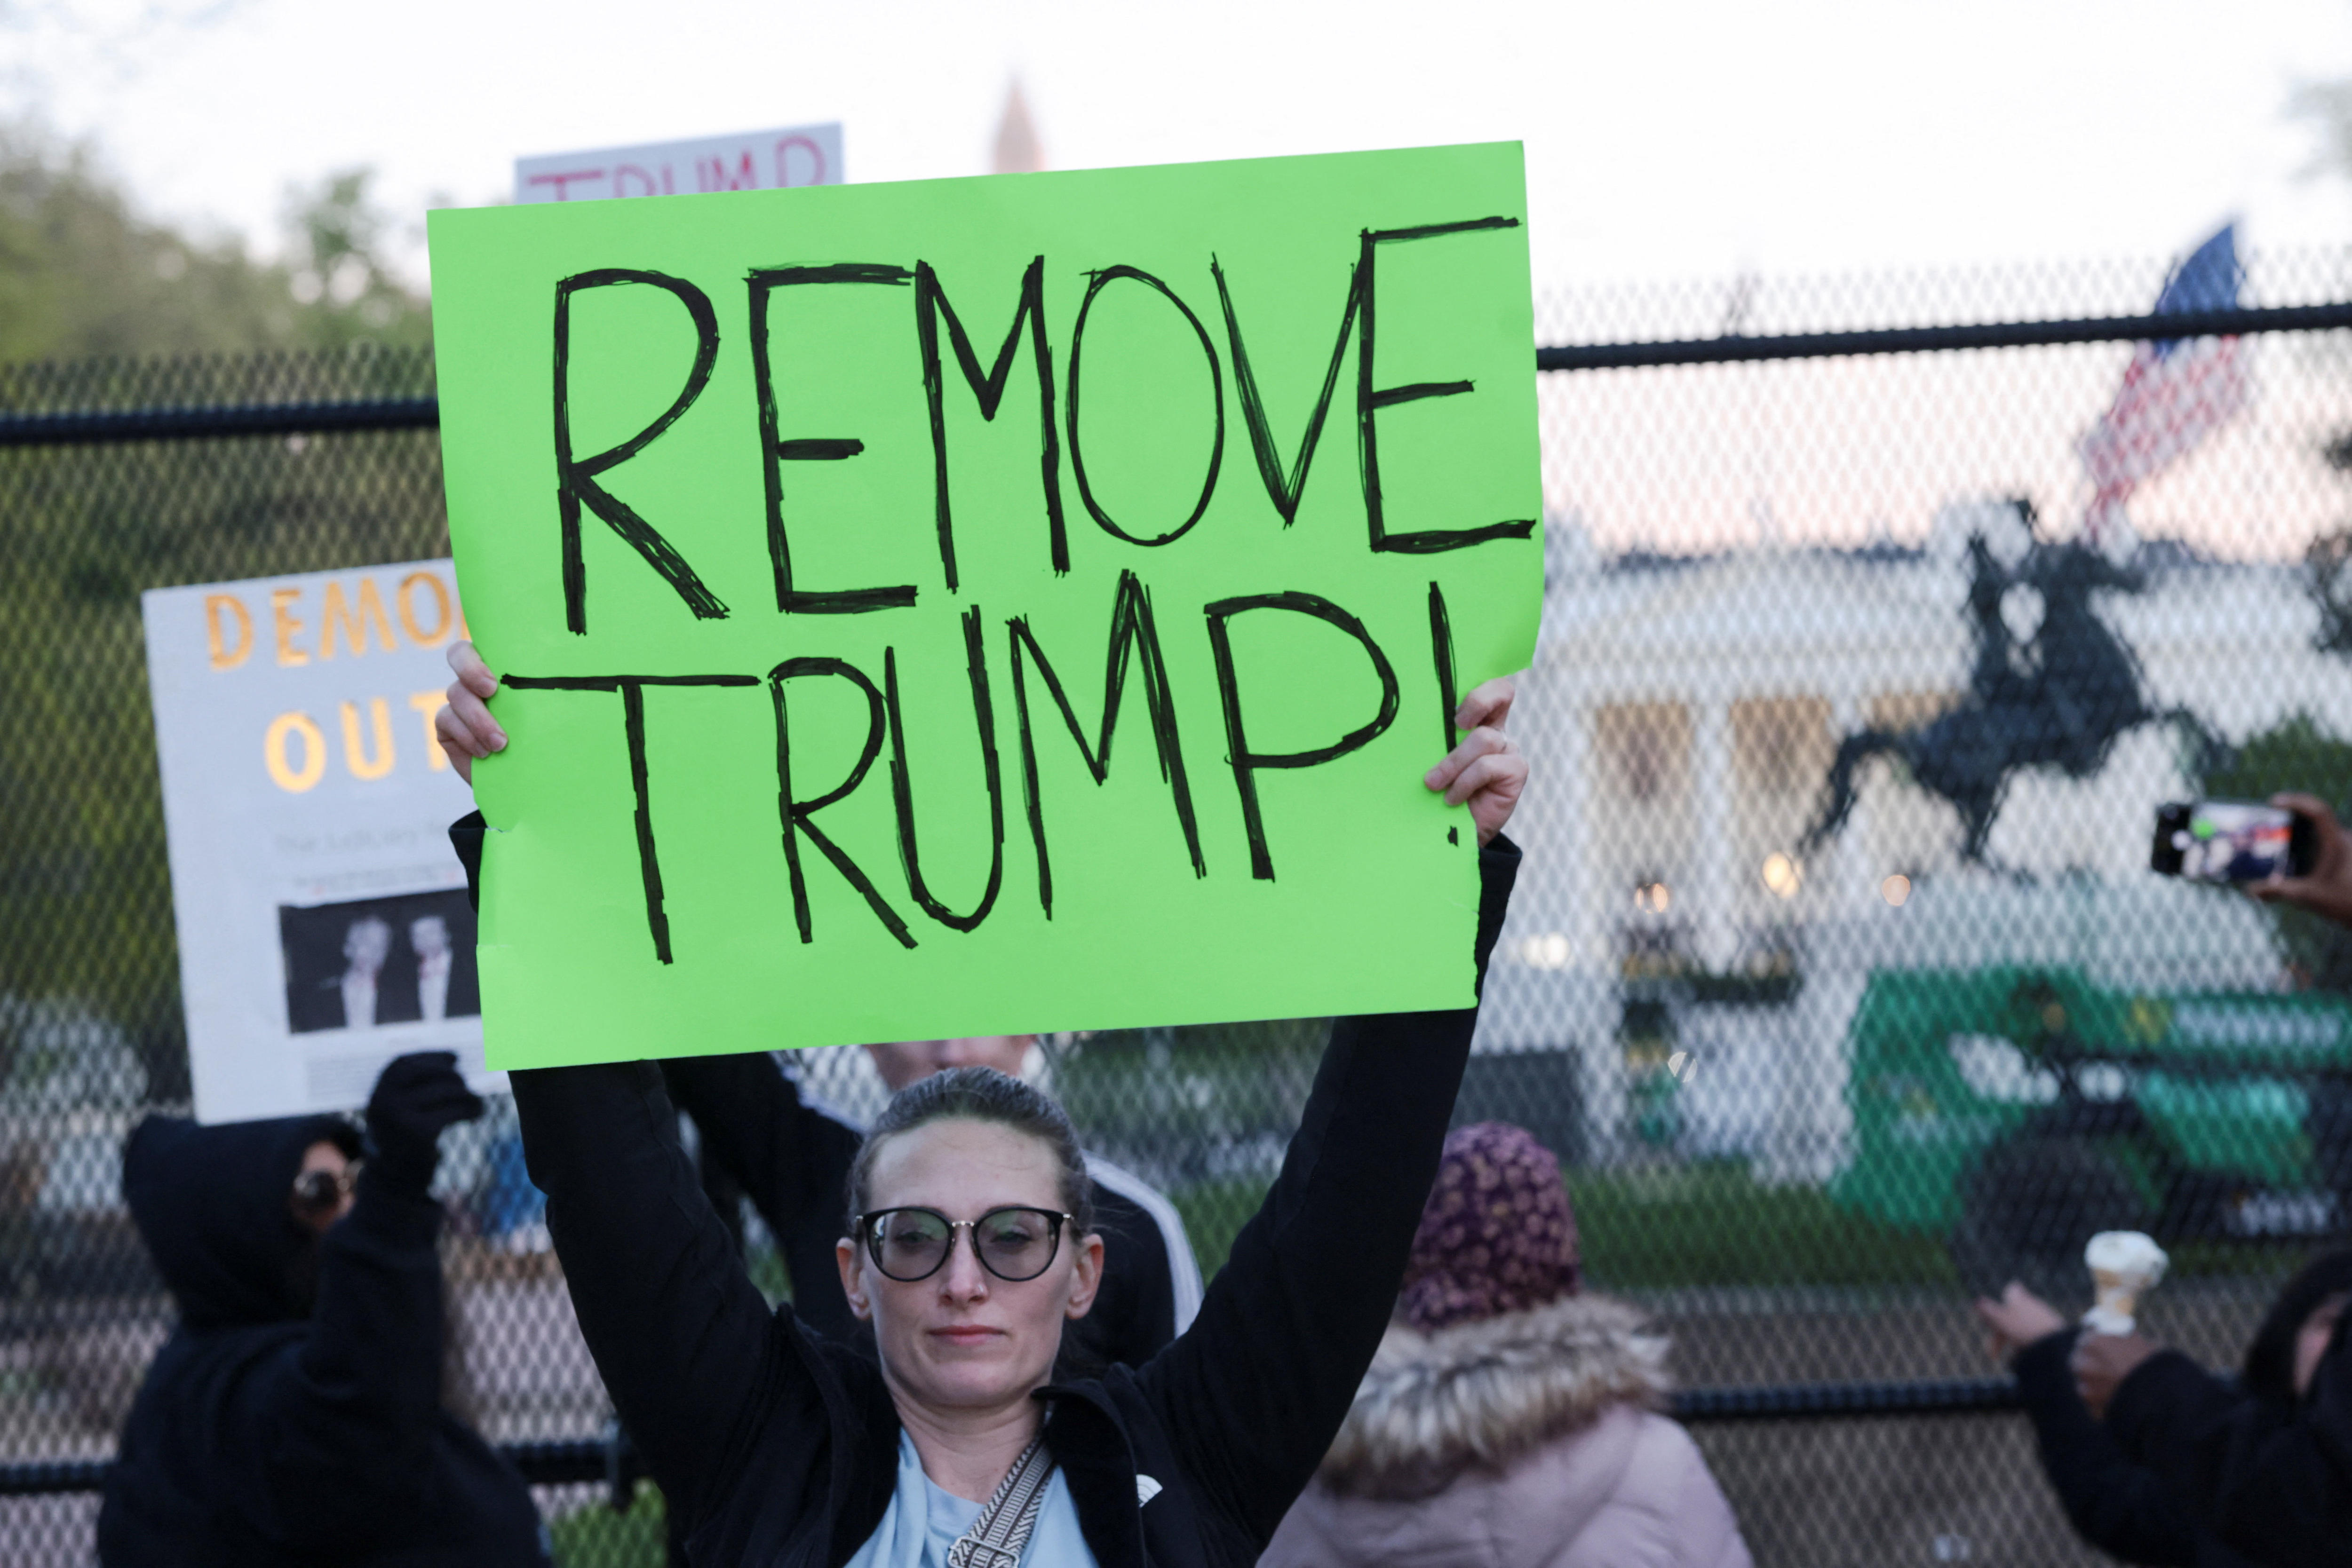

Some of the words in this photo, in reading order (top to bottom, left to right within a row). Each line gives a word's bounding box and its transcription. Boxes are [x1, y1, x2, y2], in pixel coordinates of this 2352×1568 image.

[553, 216, 1536, 636] REMOVE
[203, 570, 472, 673] DEMO
[263, 689, 450, 794] OUT
[500, 569, 1459, 965] TRUMP!
